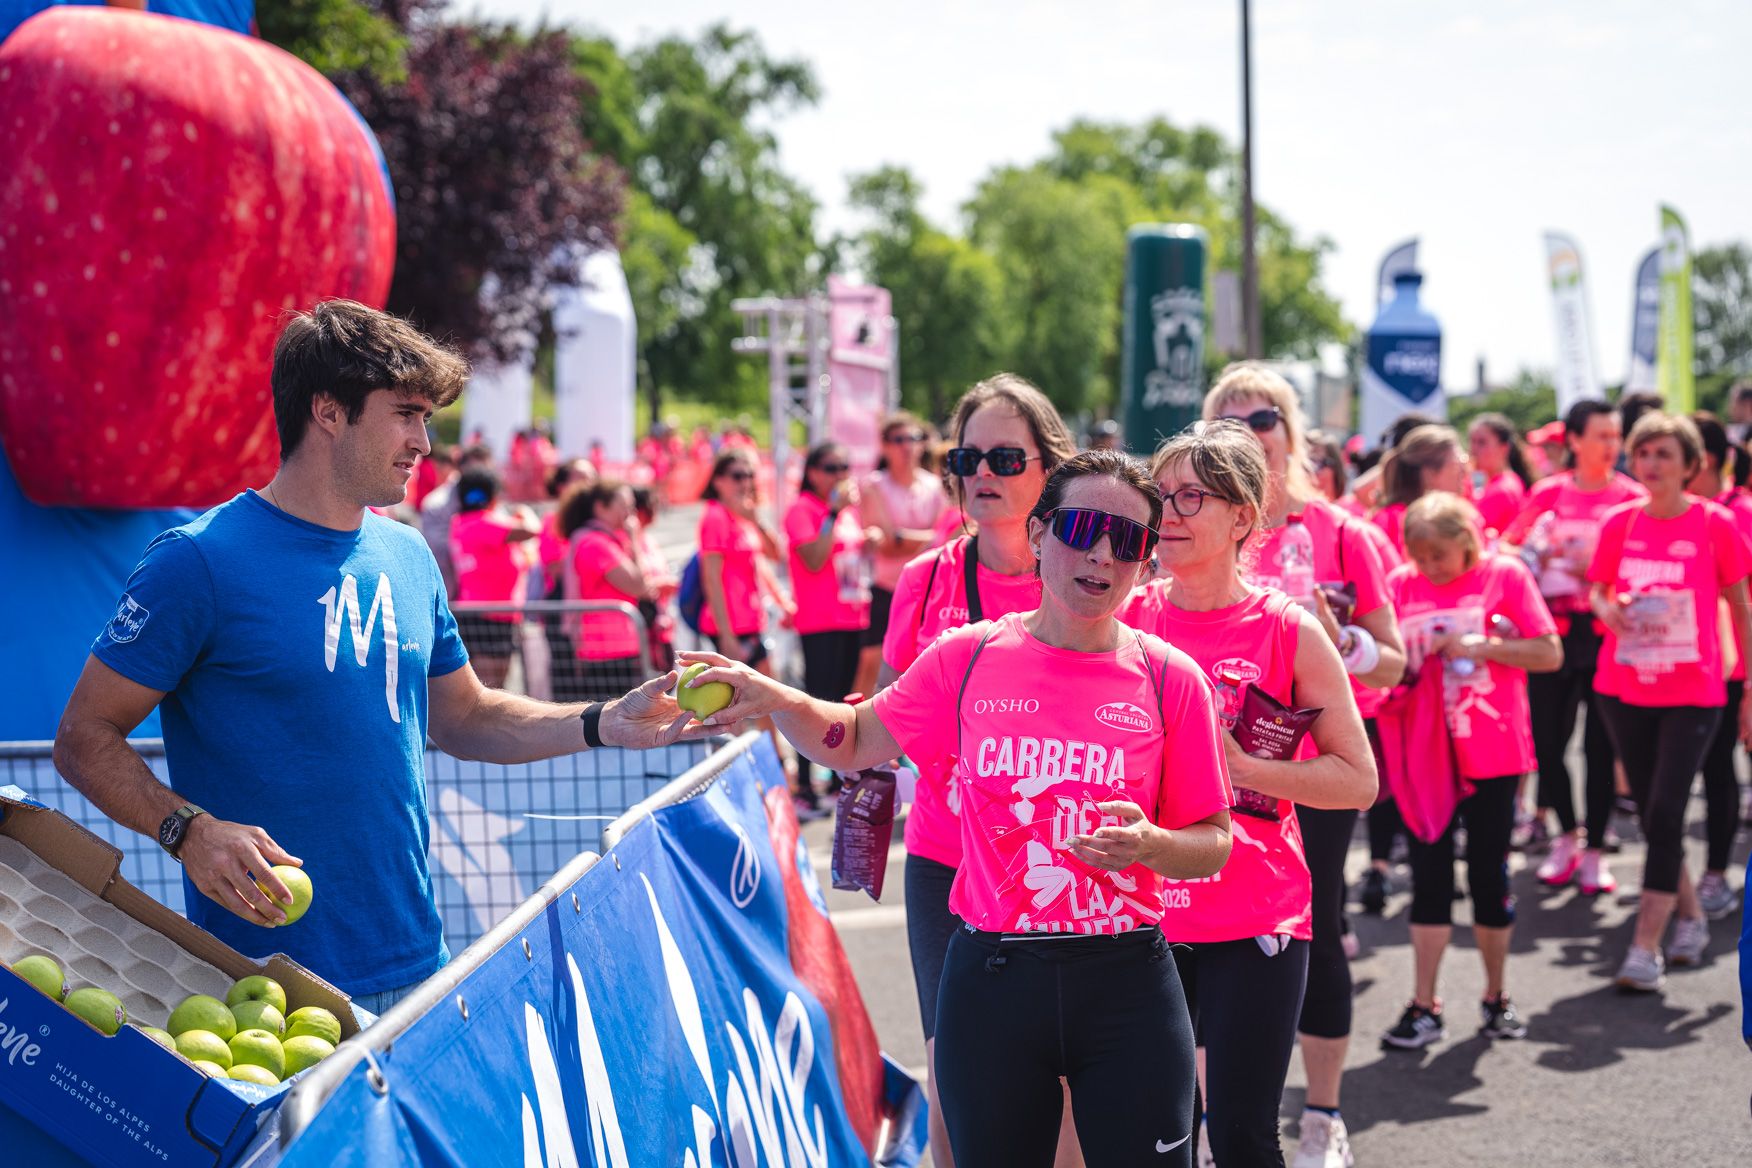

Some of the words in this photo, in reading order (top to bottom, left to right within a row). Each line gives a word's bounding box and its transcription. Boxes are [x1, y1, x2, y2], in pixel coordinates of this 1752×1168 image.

[974, 699, 1040, 714] OYSHO
[1099, 708, 1148, 729] ASTURIANA
[976, 736, 1126, 789] CARRERA
[1069, 872, 1102, 920] LA
[50, 1073, 102, 1115] DAUGHTER
[105, 1113, 119, 1125] OF
[122, 1124, 141, 1142] THE
[143, 1140, 169, 1161] ALPS
[55, 1062, 77, 1082] HIJA
[81, 1080, 94, 1094] DE
[97, 1091, 116, 1109] LOS
[119, 1107, 150, 1132] ALPES
